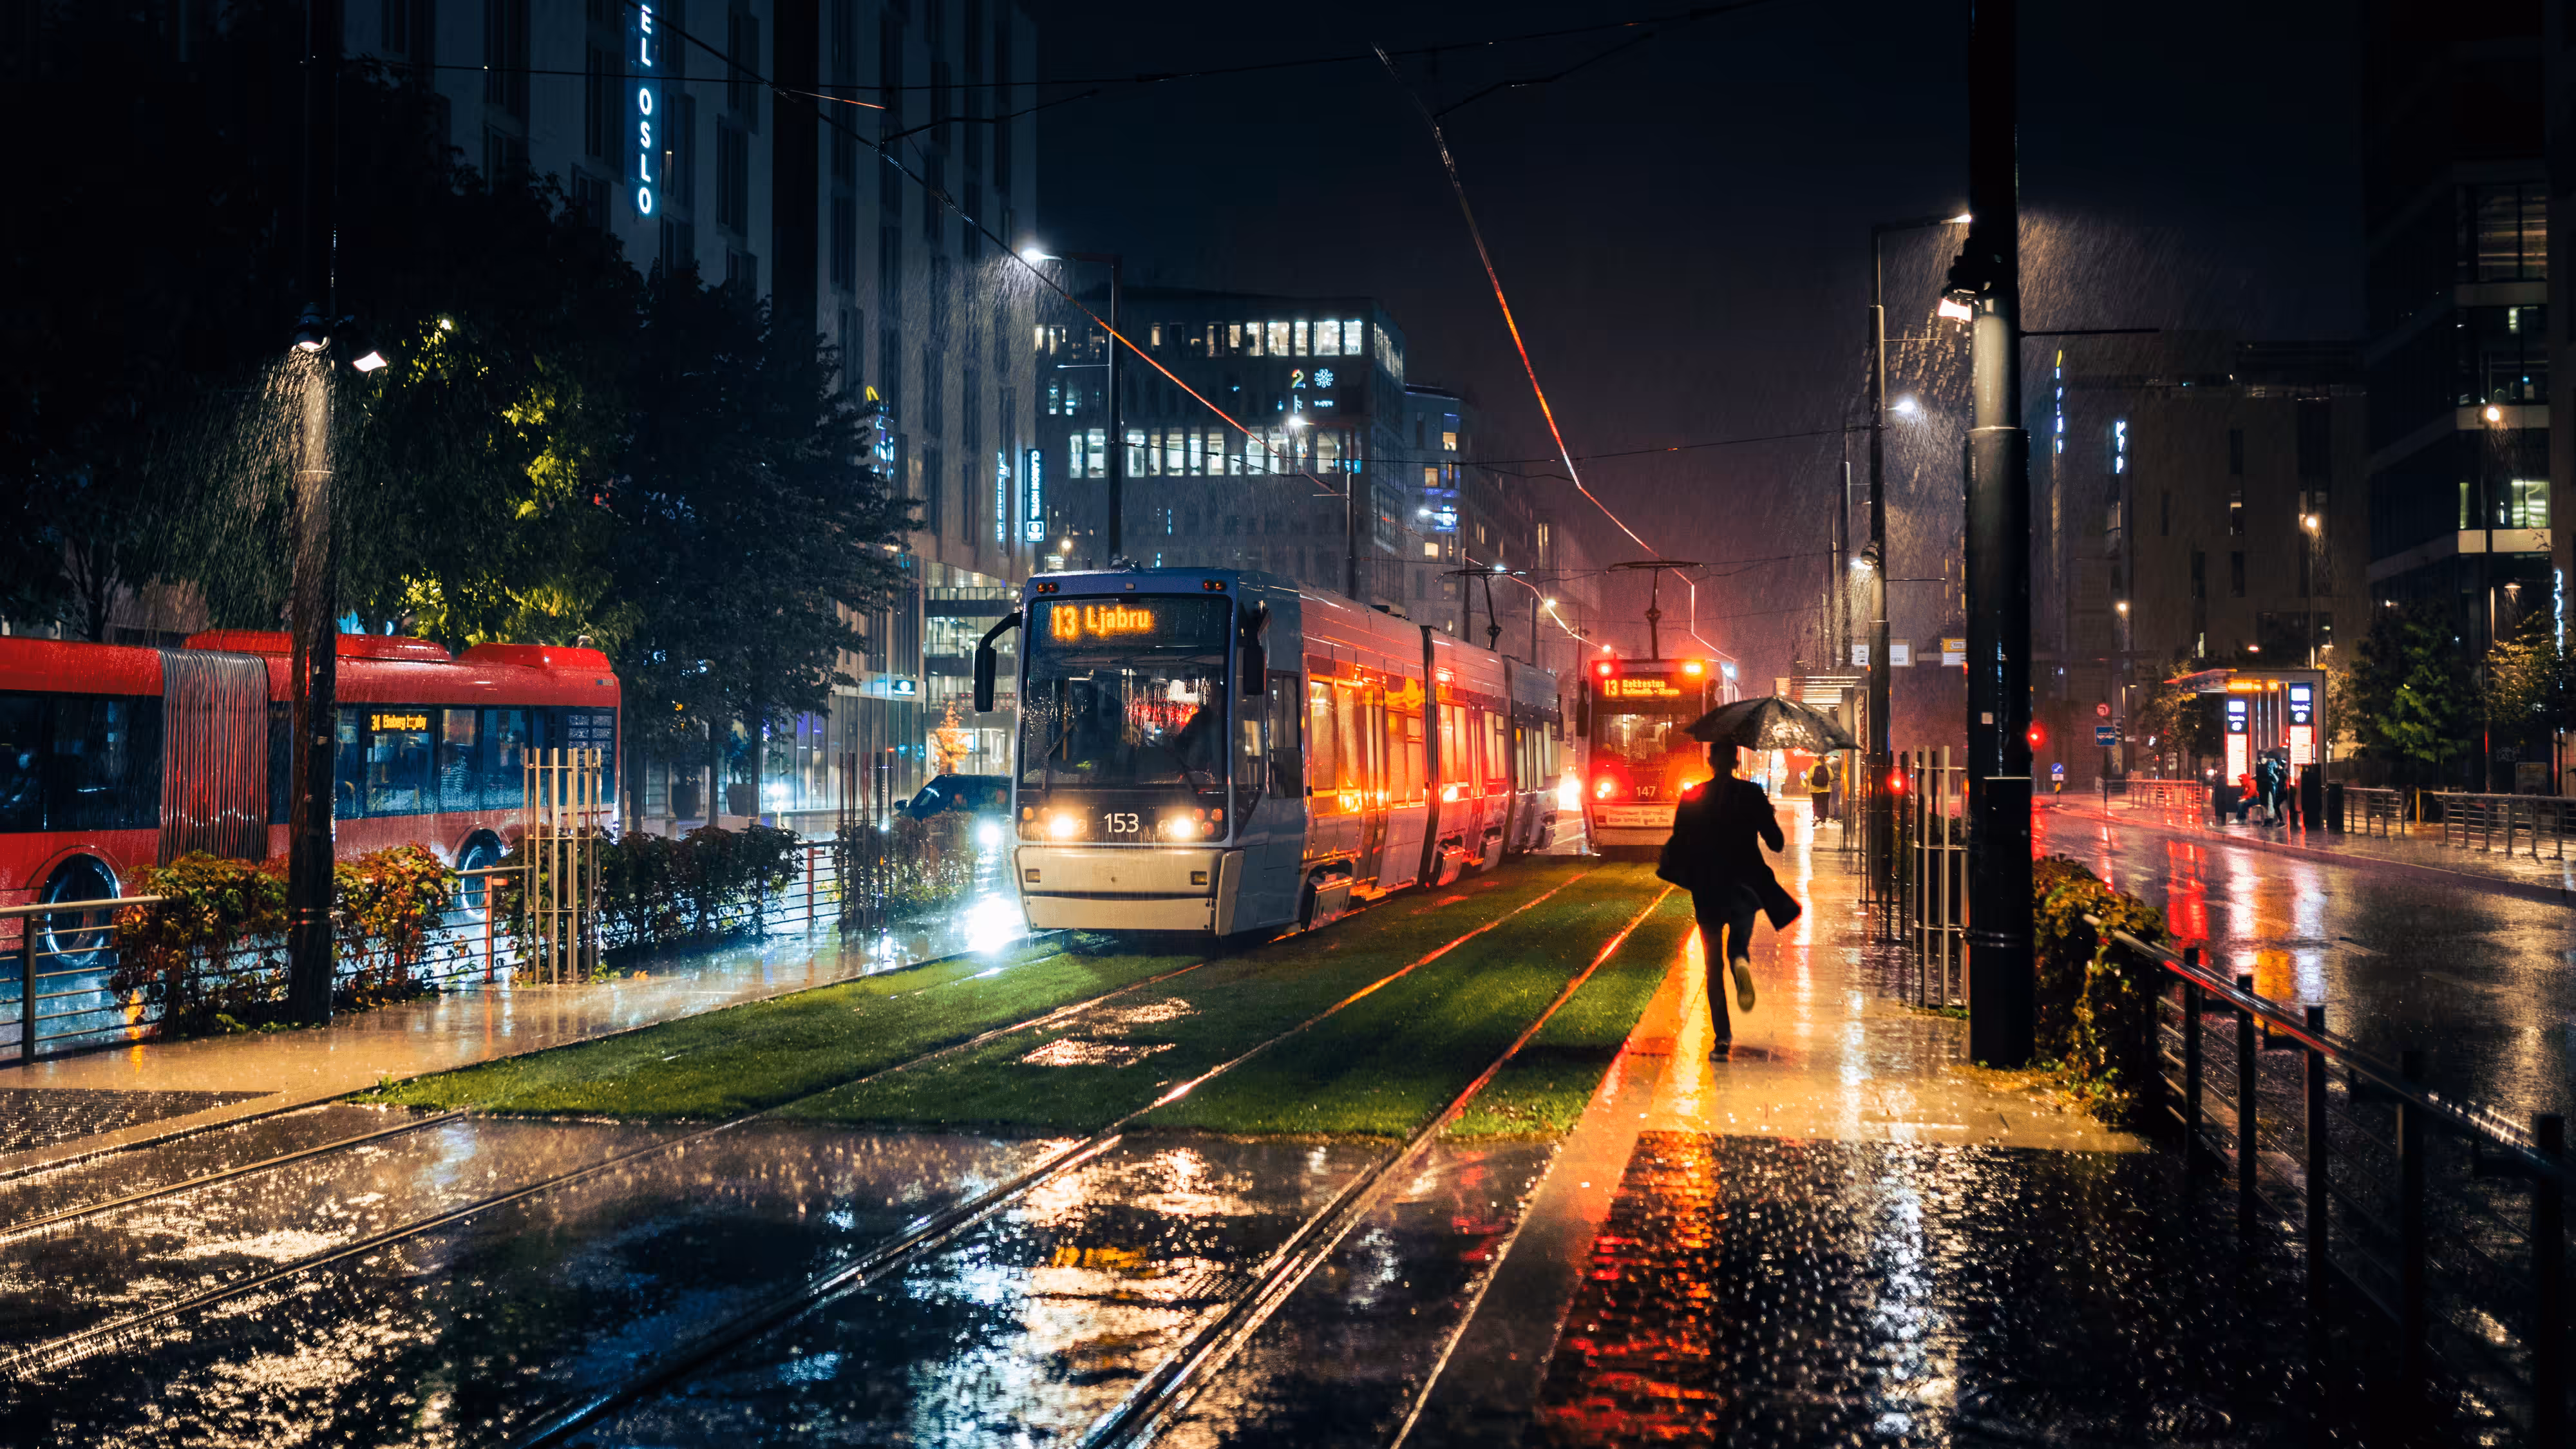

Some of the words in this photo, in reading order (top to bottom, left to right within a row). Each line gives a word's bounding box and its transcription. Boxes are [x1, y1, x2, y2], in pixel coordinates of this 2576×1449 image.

[639, 88, 652, 214] OSLO
[1031, 490, 1040, 520] HOTEL
[1053, 606, 1076, 636] 13
[1086, 606, 1150, 634] Ljabru
[1604, 679, 1618, 696] 13
[1636, 786, 1656, 797] 147
[1103, 812, 1139, 833] 153
